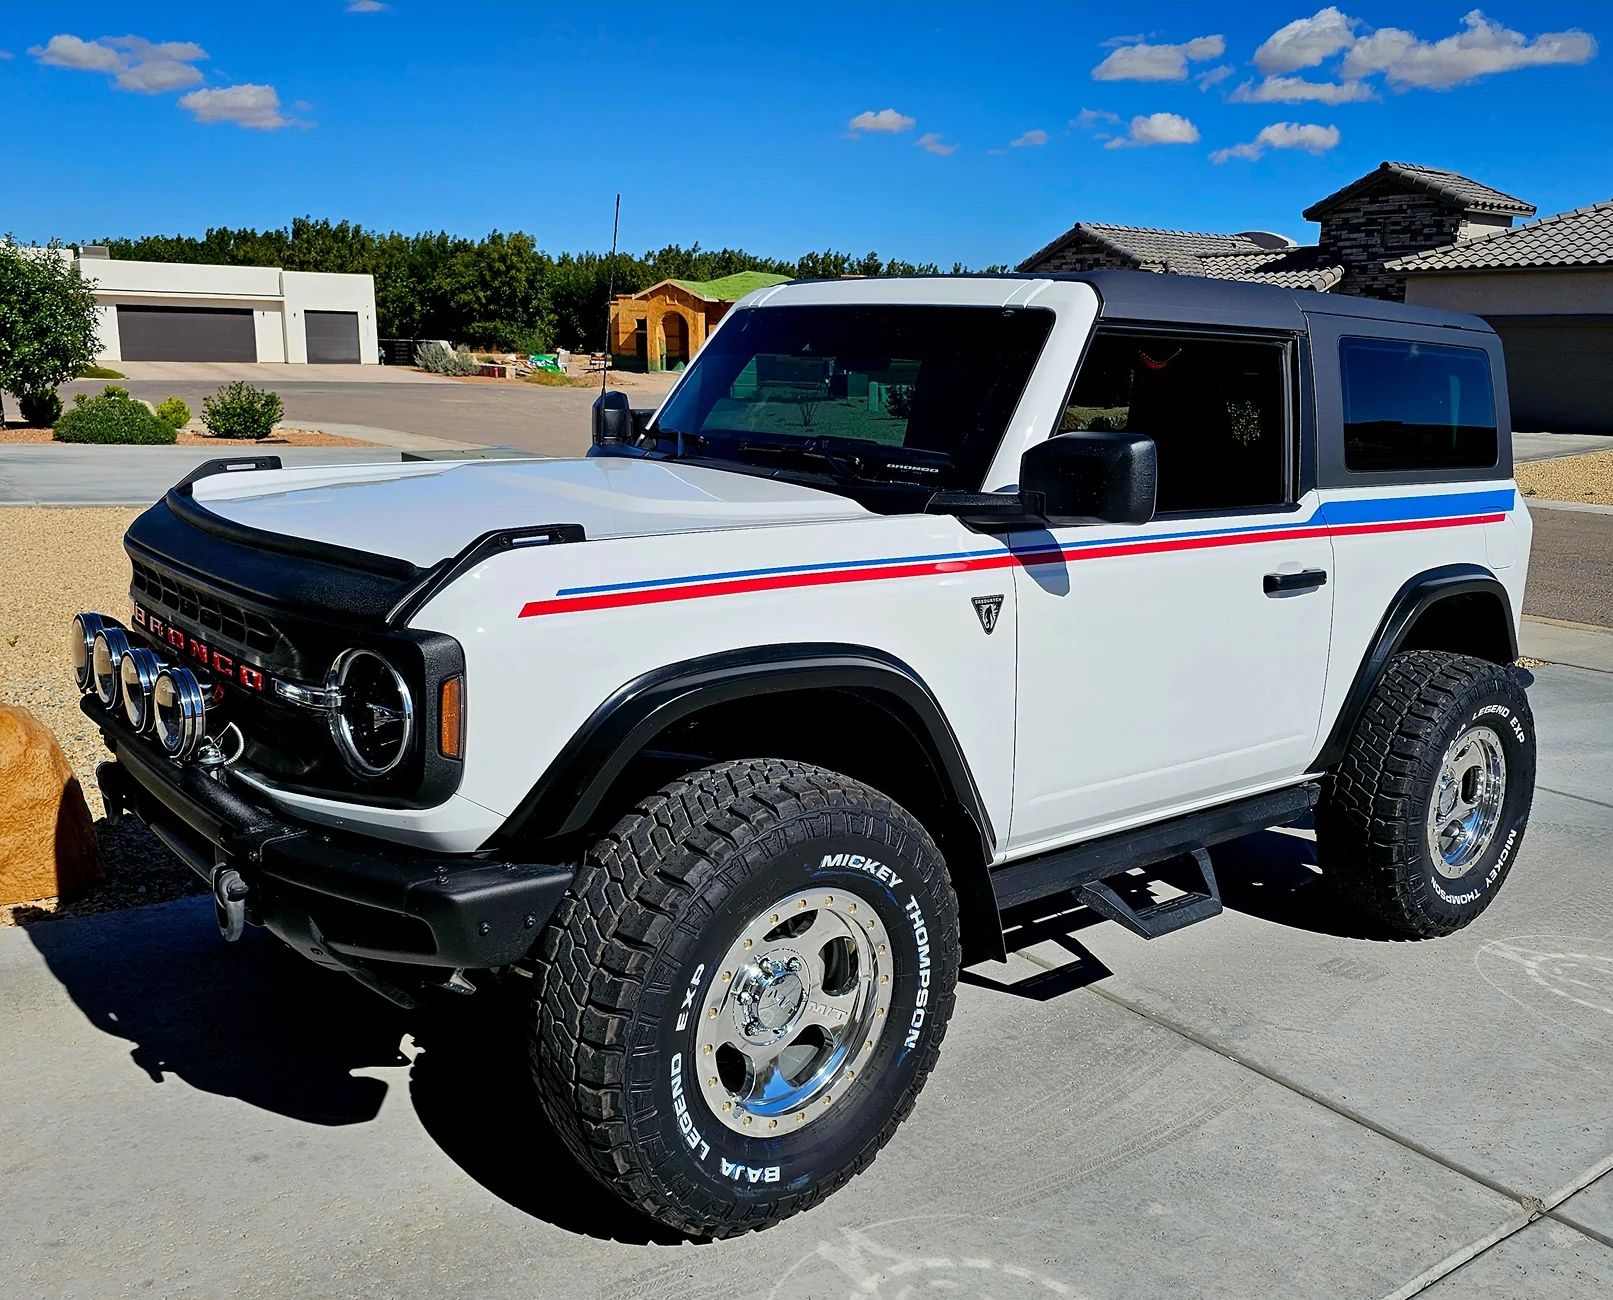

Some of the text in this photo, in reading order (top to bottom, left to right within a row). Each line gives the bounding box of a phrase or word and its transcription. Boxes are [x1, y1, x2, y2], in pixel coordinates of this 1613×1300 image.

[887, 463, 939, 473] BRONCO
[134, 604, 263, 691] BRONCO
[1471, 704, 1511, 721] LEGEND
[1509, 716, 1526, 743] EXP
[1430, 828, 1518, 905] MICKEY THOMPSON
[820, 853, 935, 1050] MICKEY THOMPSON
[671, 963, 780, 1183] BAJA LEGEND EXP
